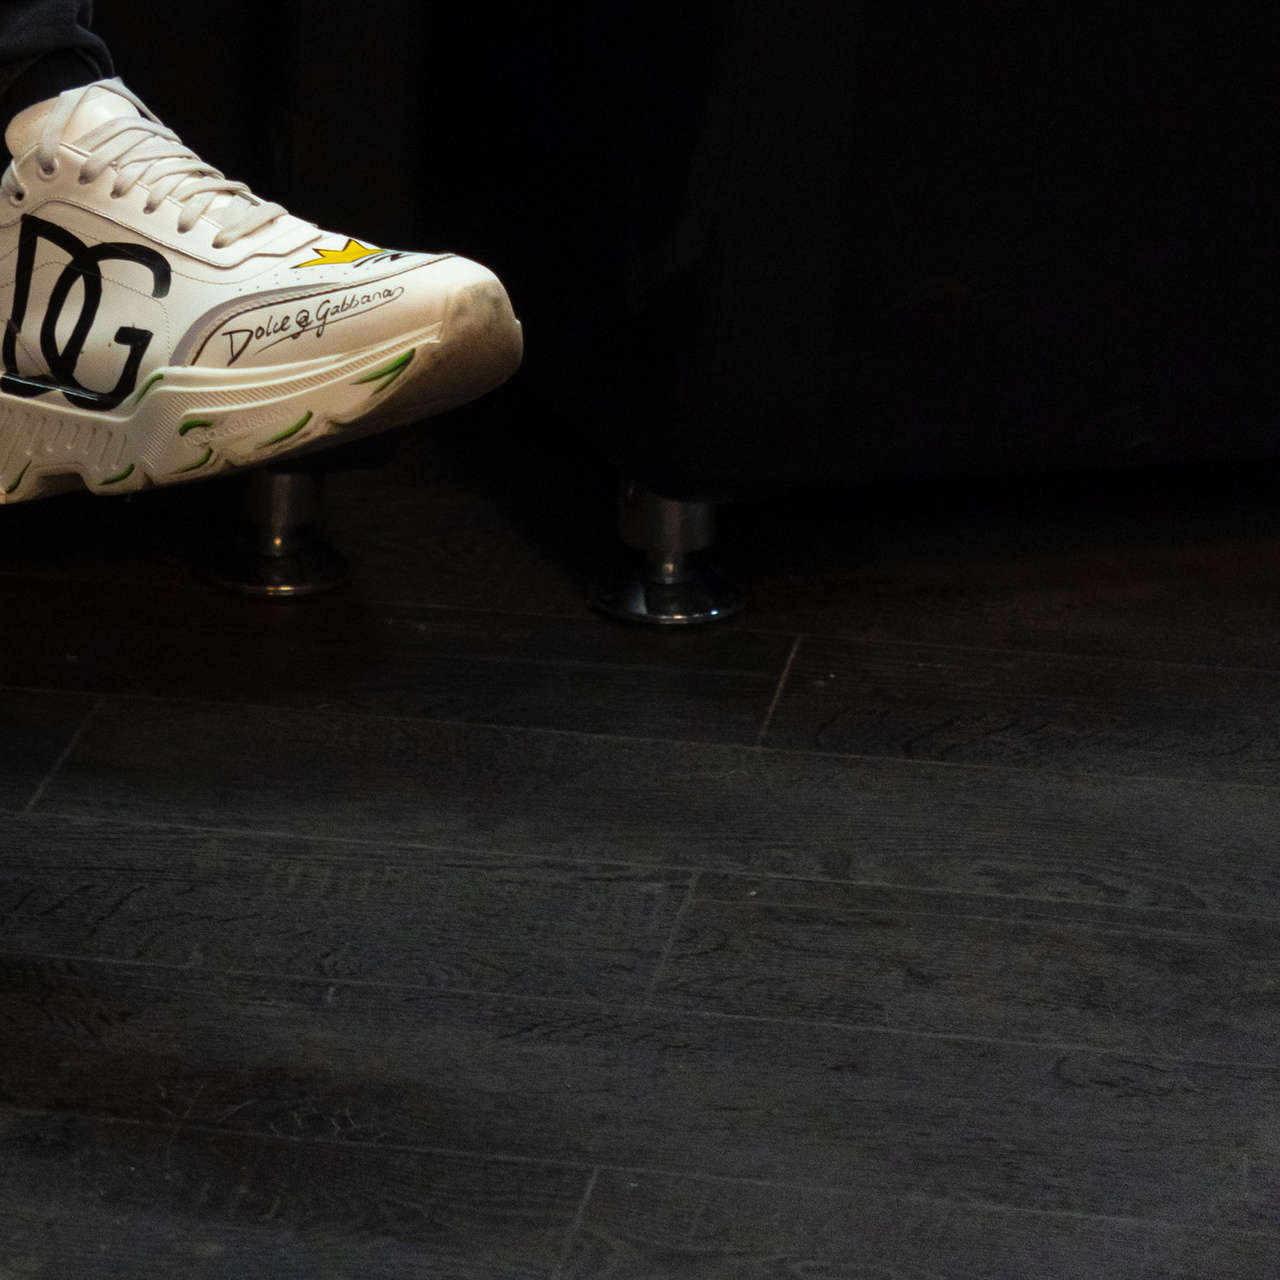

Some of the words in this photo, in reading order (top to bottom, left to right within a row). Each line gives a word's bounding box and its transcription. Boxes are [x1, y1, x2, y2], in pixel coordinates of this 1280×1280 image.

[0, 212, 172, 412] DG
[221, 315, 292, 367] Dolce
[314, 286, 405, 338] Gabbana
